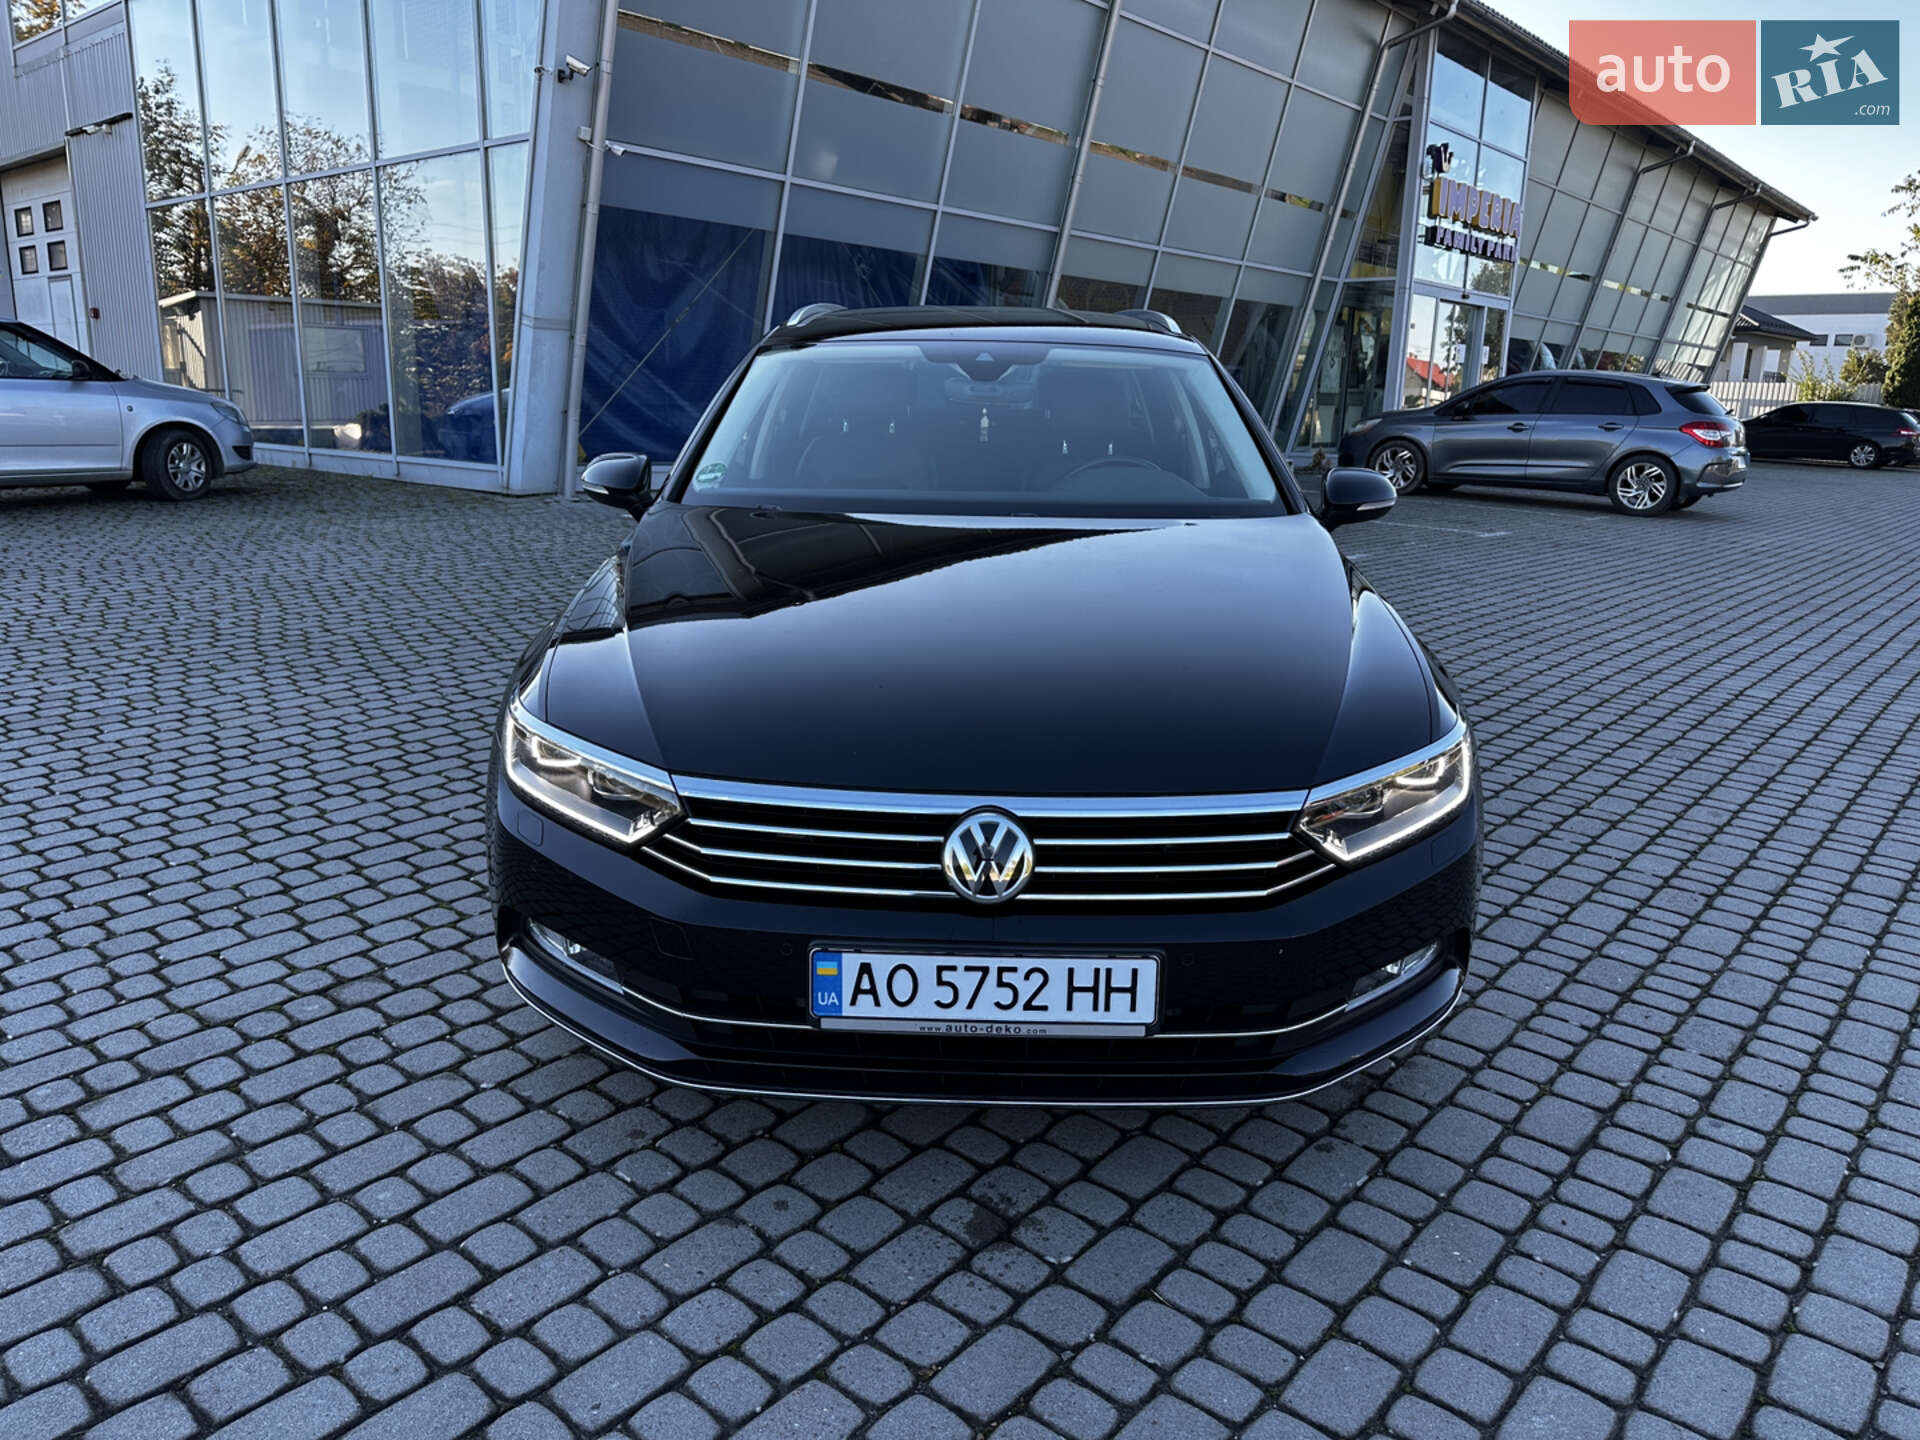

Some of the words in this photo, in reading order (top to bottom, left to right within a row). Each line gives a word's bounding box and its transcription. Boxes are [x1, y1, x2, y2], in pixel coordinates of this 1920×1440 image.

[1433, 176, 1521, 238] IMPERIA
[1436, 226, 1485, 255] FAMILY
[817, 991, 839, 1006] UA
[849, 962, 919, 1008] AO
[934, 965, 1049, 1011] 5752
[1066, 967, 1138, 1013] HH
